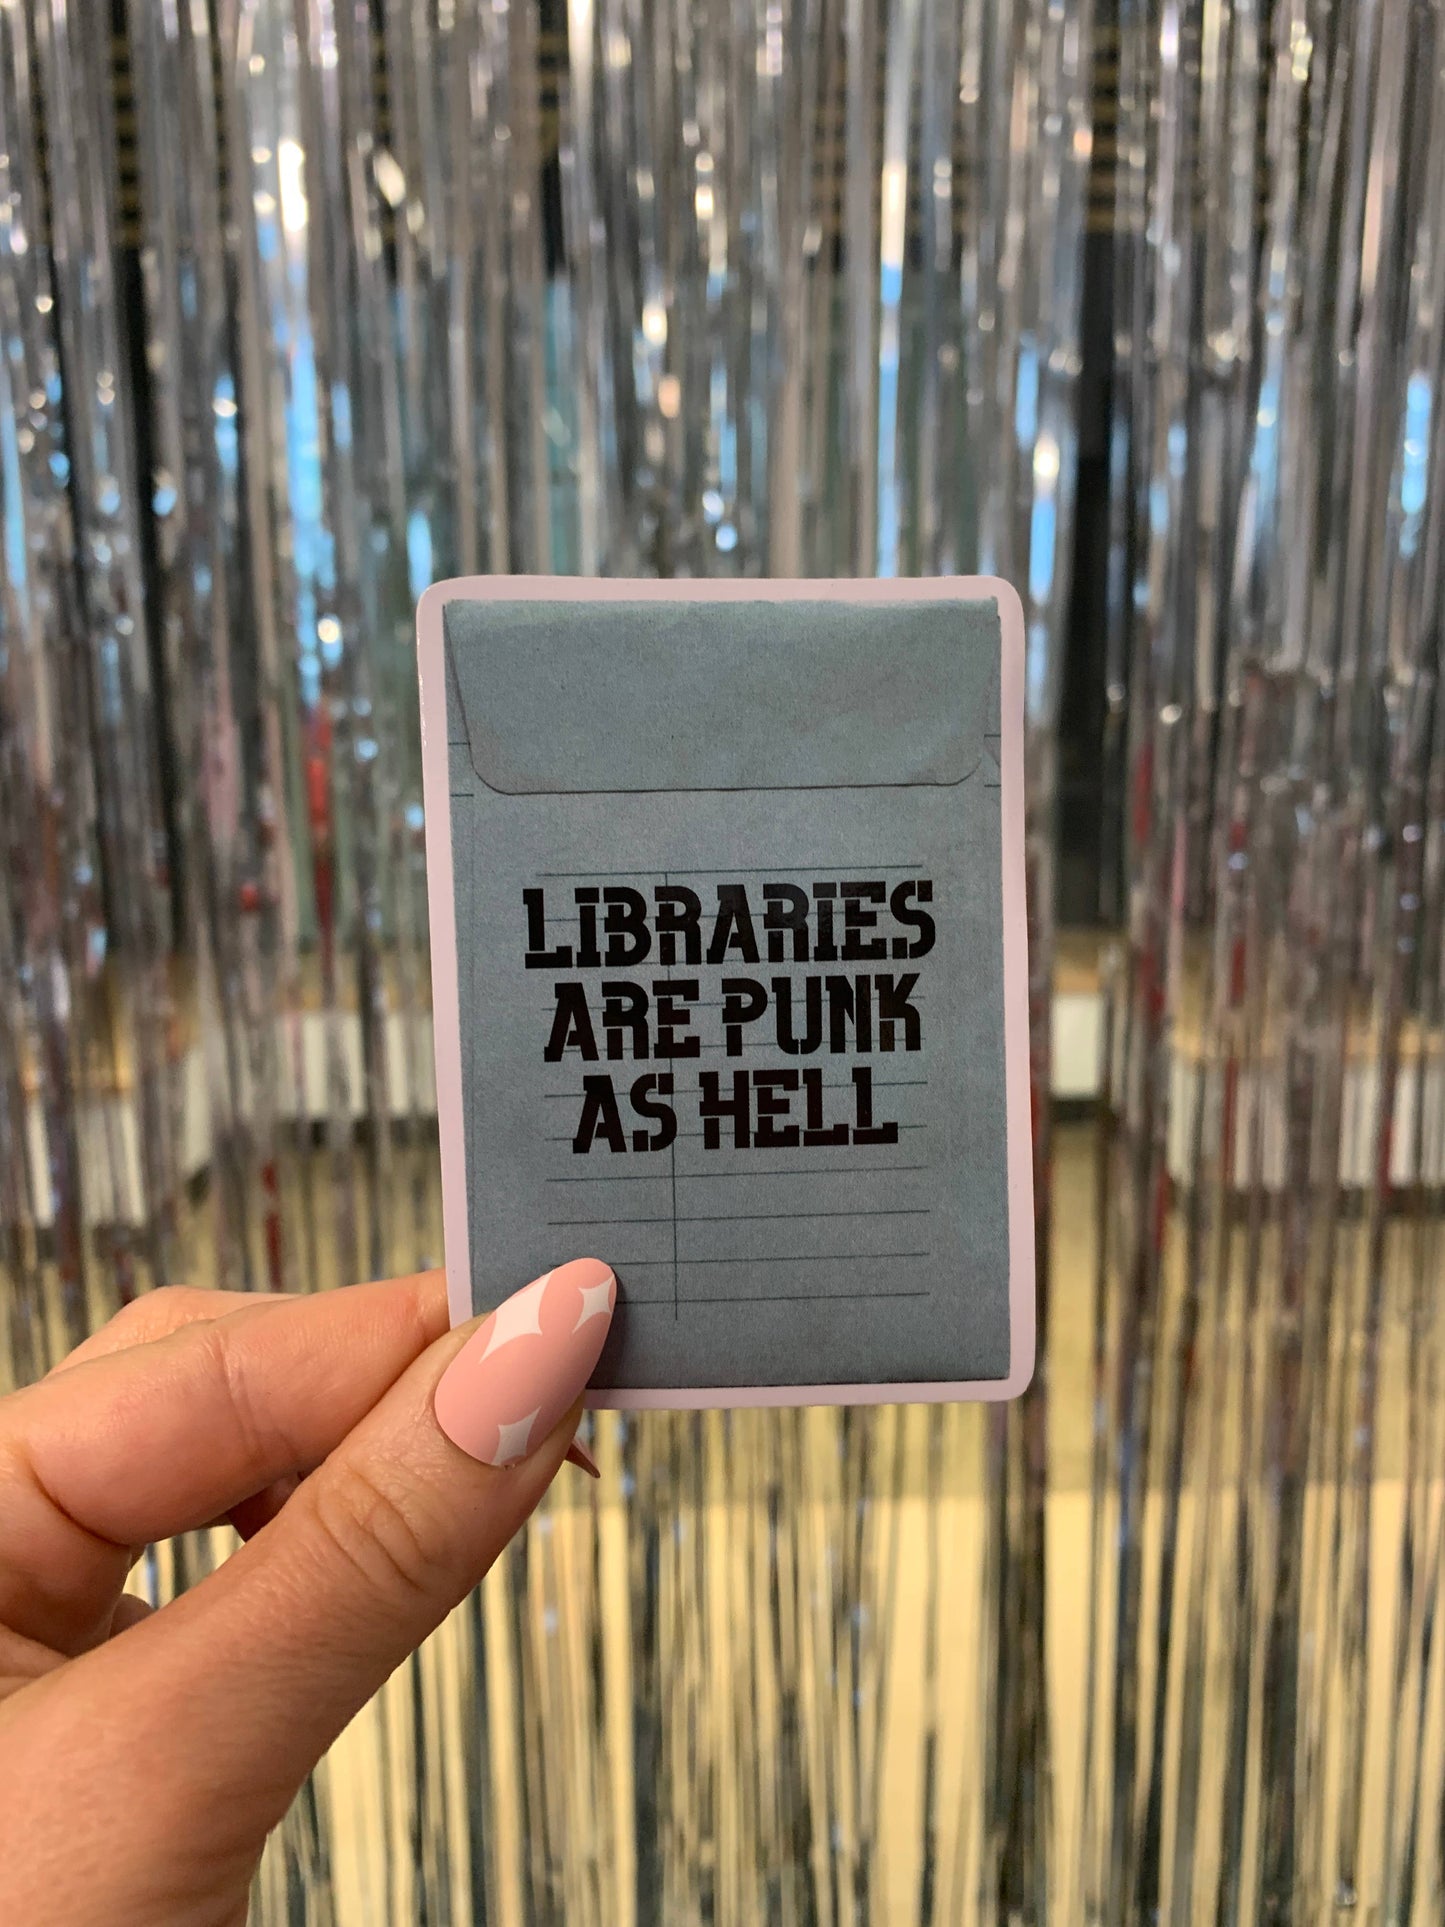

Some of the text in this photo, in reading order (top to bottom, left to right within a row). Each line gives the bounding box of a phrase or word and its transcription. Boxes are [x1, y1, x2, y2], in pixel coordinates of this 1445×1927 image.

[523, 880, 936, 969] LIBRARIES
[544, 973, 921, 1062] ARE PUNK
[572, 1067, 898, 1154] AS HELL
